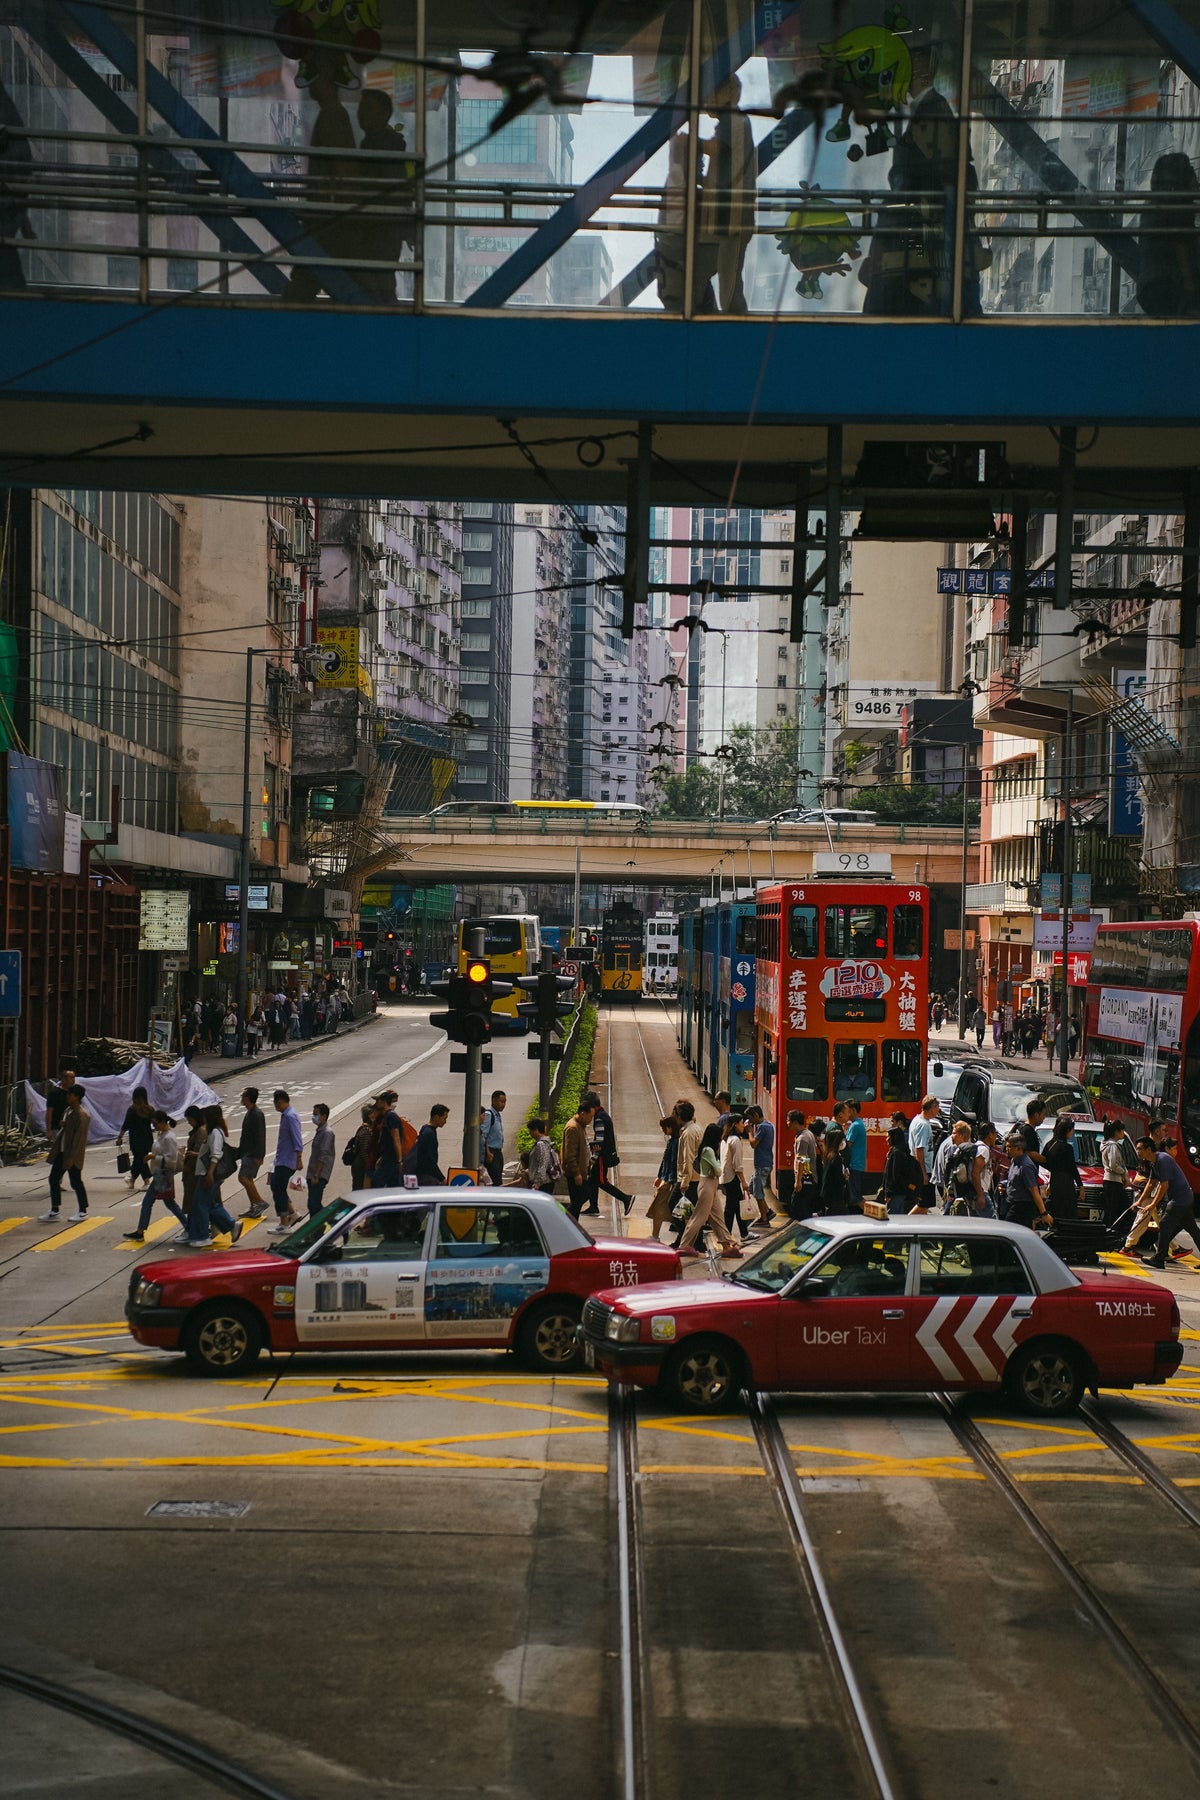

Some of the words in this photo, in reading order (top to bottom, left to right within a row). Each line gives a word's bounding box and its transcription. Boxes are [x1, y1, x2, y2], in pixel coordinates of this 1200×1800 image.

[855, 702, 891, 714] 9486
[838, 854, 870, 870] 98
[791, 890, 805, 901] 98
[908, 890, 922, 902] 98
[833, 963, 879, 986] 1210
[787, 969, 808, 1031] 幸運兒
[898, 970, 917, 1032] 大抽獎
[1101, 995, 1128, 1016] GIORDANO
[609, 1259, 638, 1273] 的士
[610, 1272, 639, 1287] TAXI
[1095, 1301, 1127, 1317] TAXI
[1127, 1302, 1156, 1317] 的士
[803, 1326, 851, 1345] Uber
[853, 1326, 887, 1345] Taxi
